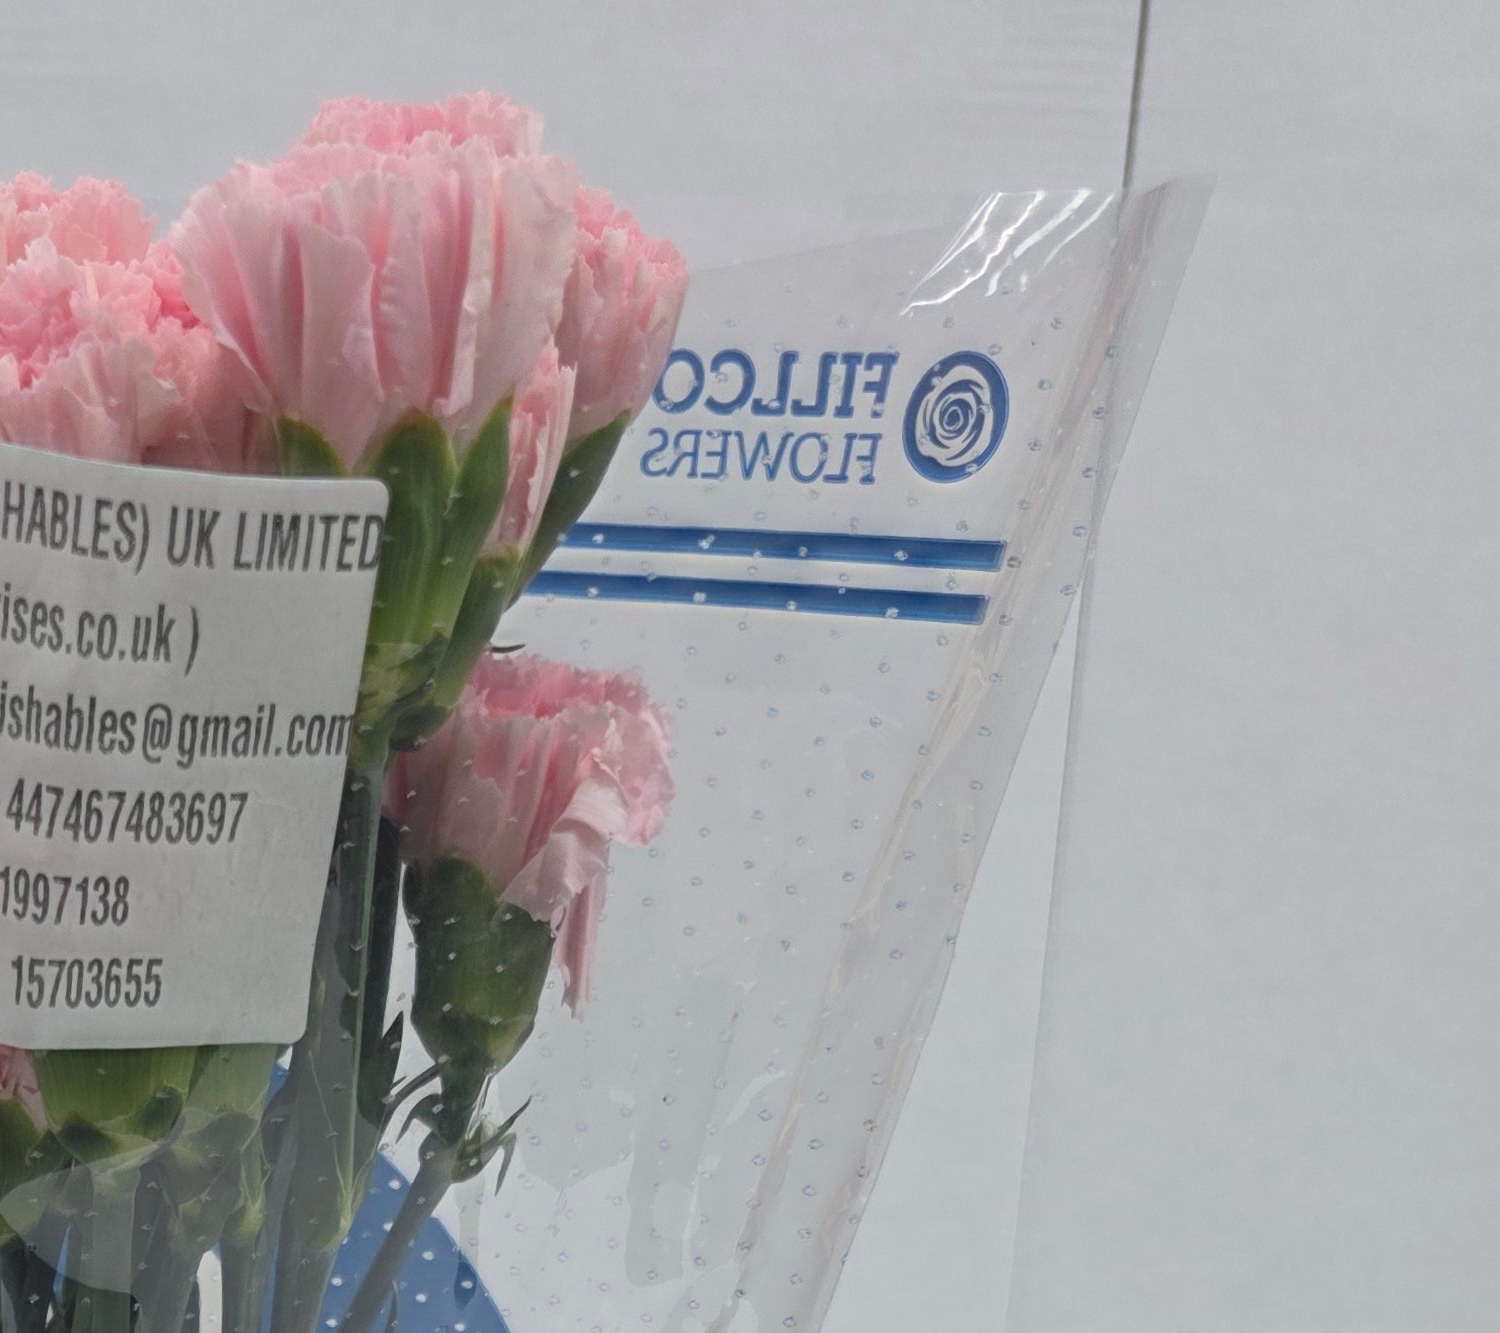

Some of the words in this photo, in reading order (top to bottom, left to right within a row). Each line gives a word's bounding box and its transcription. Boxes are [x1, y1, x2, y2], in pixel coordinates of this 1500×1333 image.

[167, 505, 221, 569] UK
[233, 511, 385, 573] LIMITED
[11, 955, 163, 1009] 15703655
